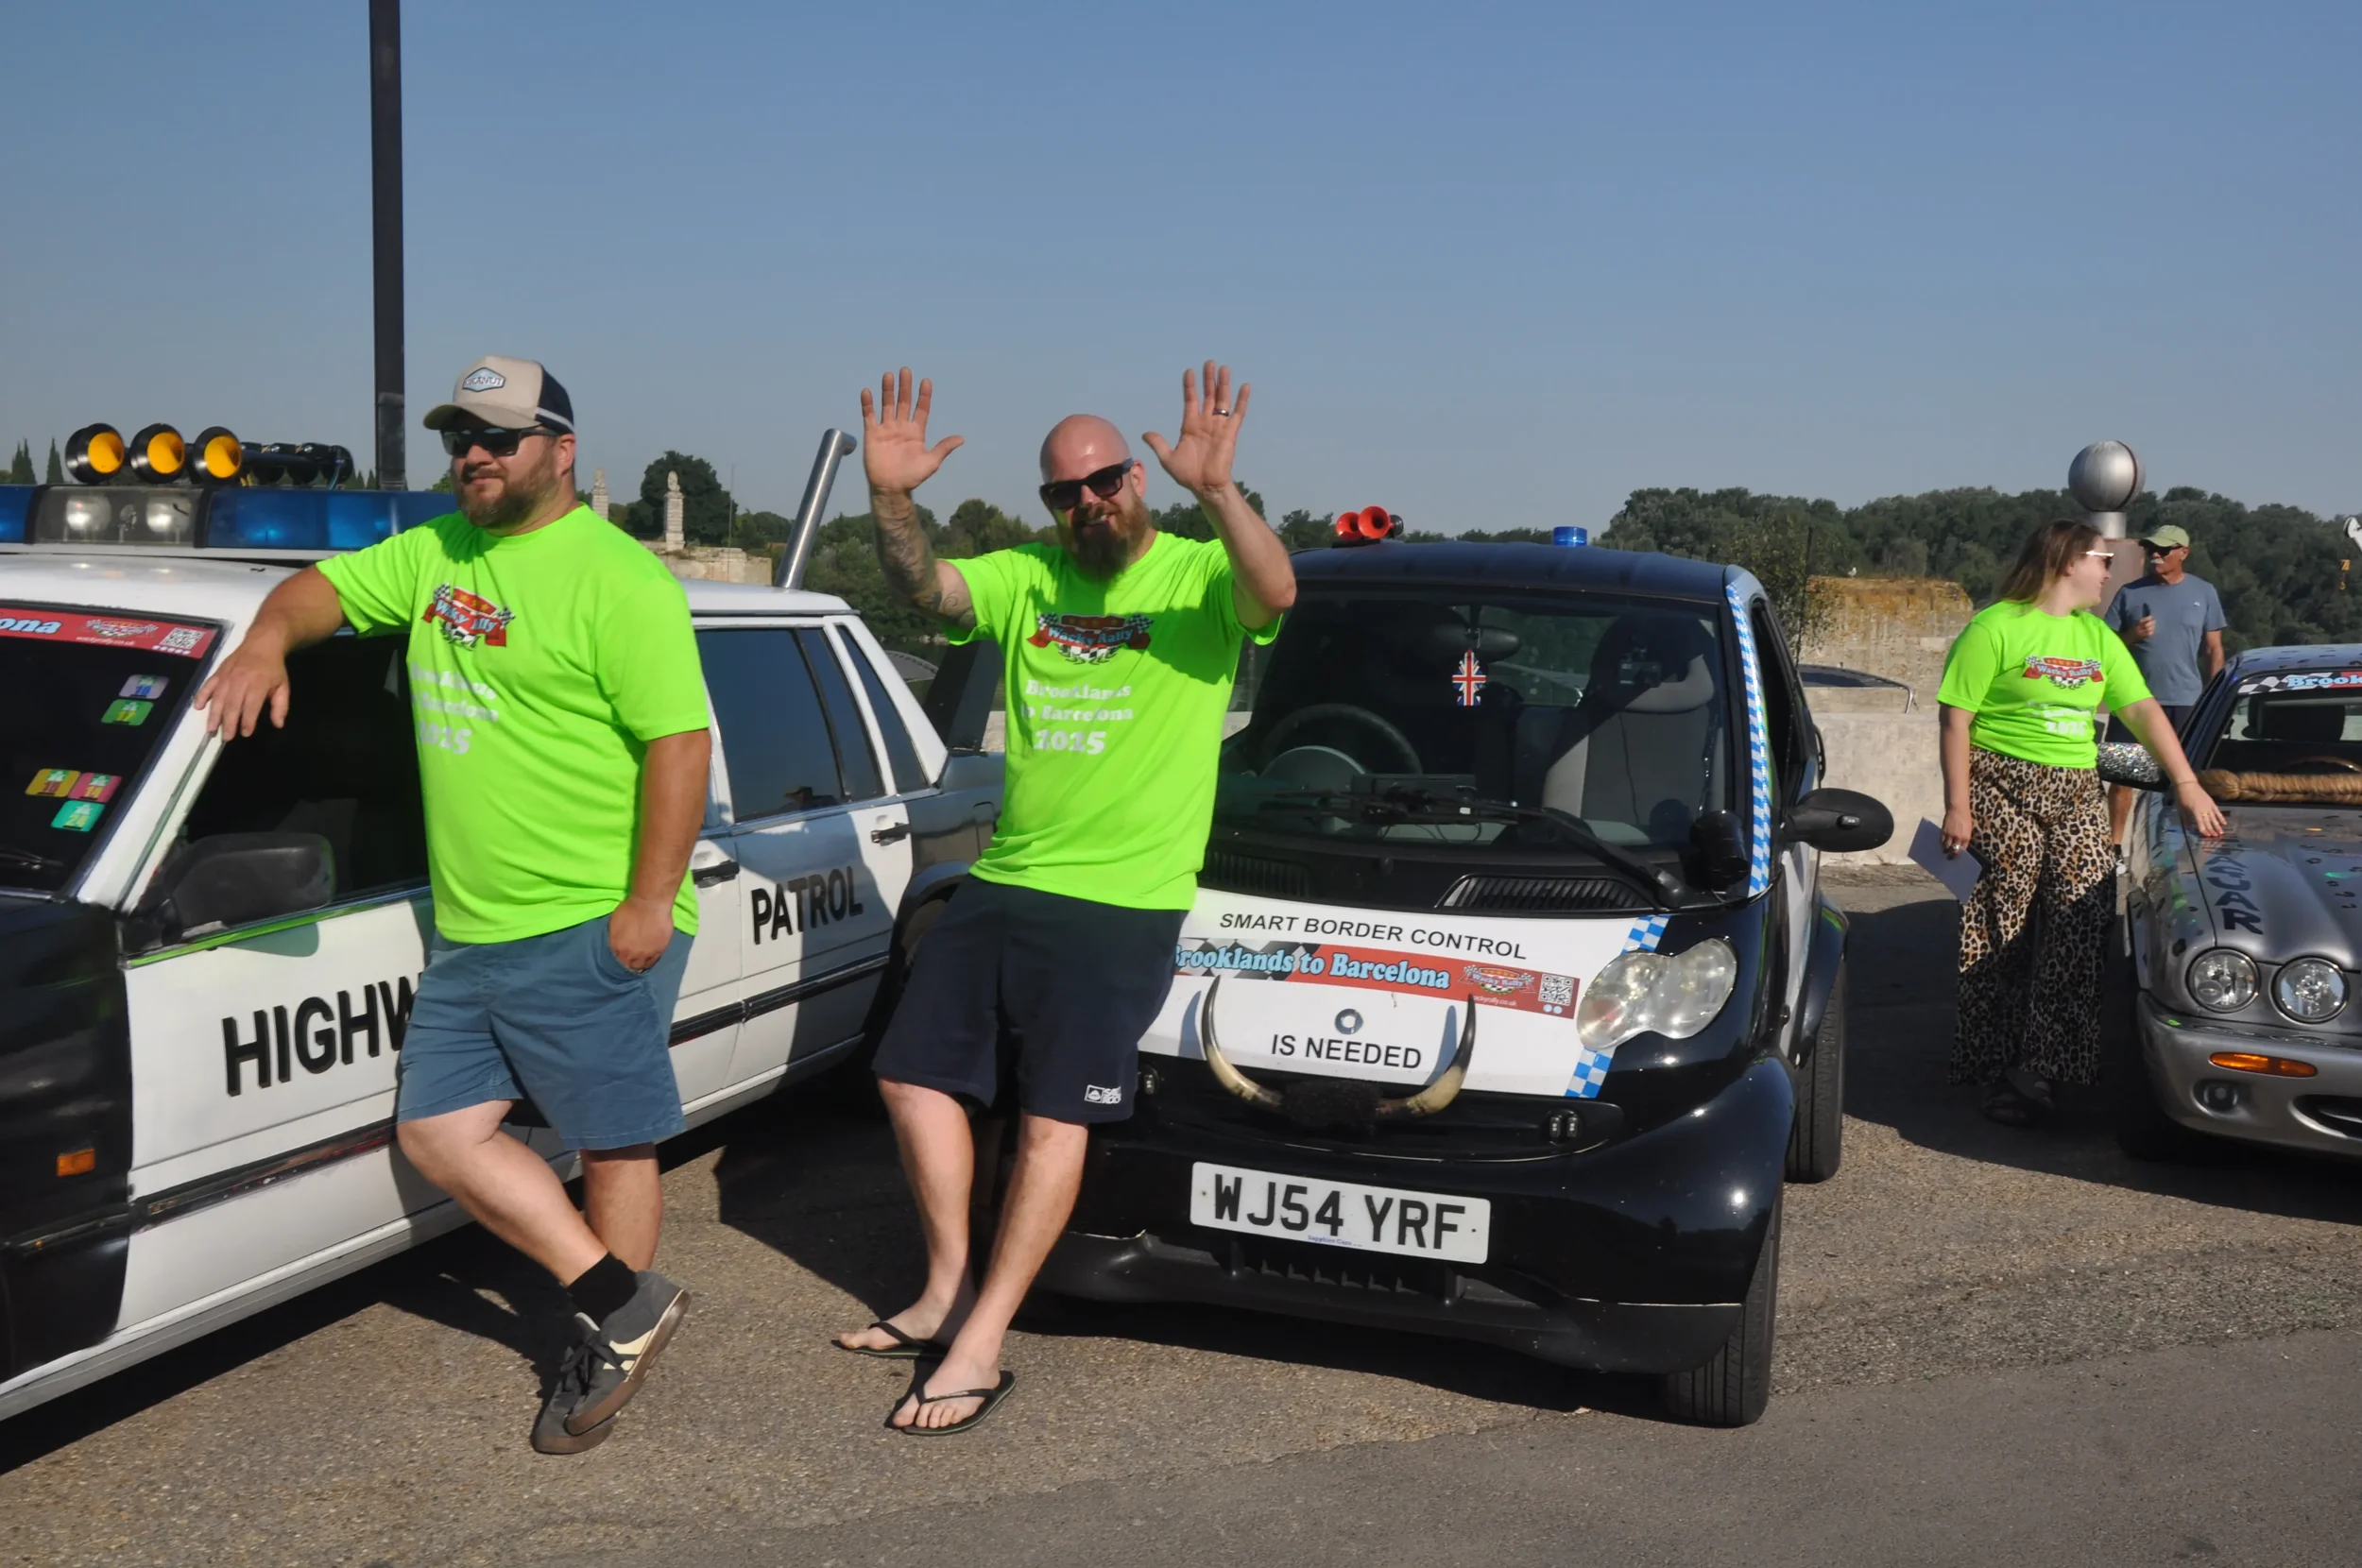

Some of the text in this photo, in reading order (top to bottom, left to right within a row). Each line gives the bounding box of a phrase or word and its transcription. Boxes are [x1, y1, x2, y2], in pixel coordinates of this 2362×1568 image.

[1034, 729, 1106, 755] 2025
[751, 865, 864, 946] PATROL
[1220, 913, 1527, 960] SMART BORDER CONTROL
[1299, 952, 1326, 975] to
[1328, 952, 1451, 990] Barcelona
[1272, 1034, 1422, 1069] IS NEEDED
[1214, 1173, 1465, 1250] WJ54 YRF
